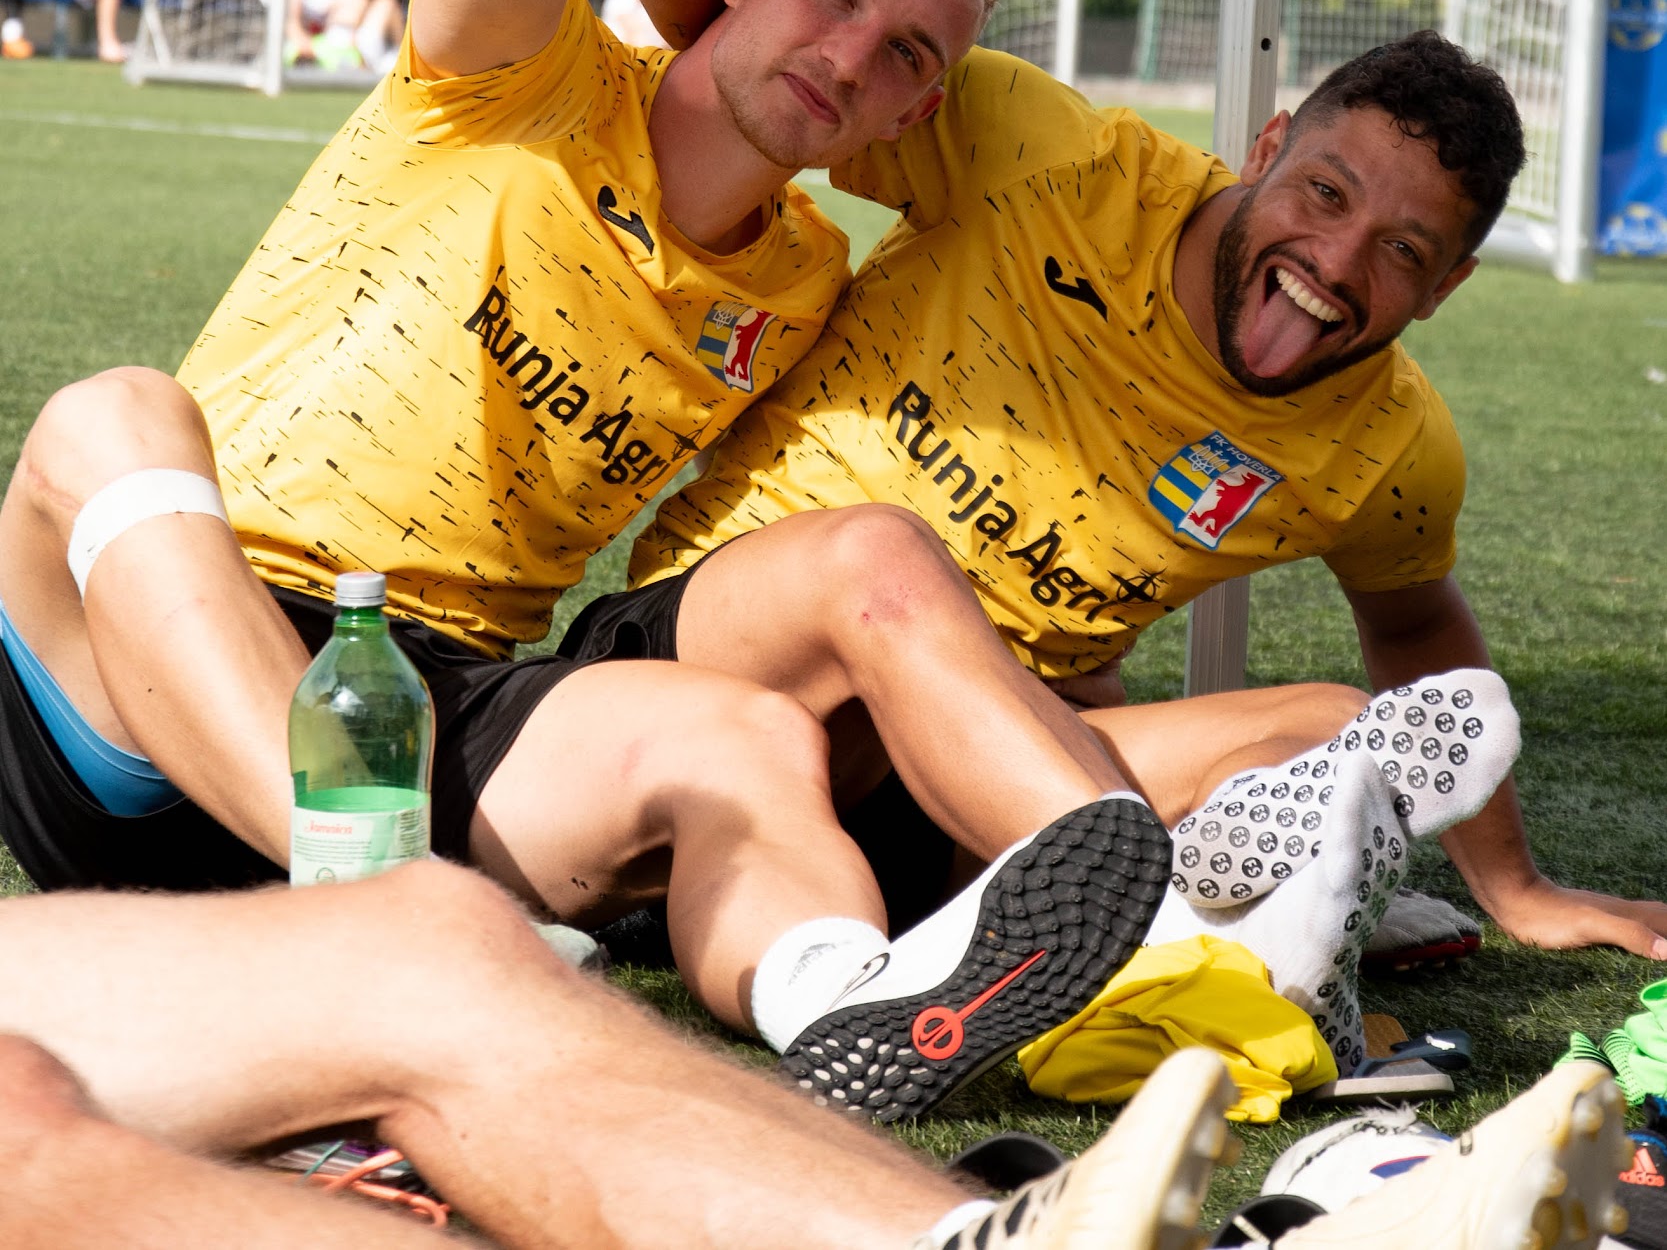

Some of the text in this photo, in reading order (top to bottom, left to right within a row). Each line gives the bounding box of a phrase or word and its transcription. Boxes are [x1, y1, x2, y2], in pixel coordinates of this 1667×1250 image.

[463, 284, 590, 427] Runja
[887, 380, 1018, 541] Runja
[1210, 434, 1282, 481] FK HOVERLA
